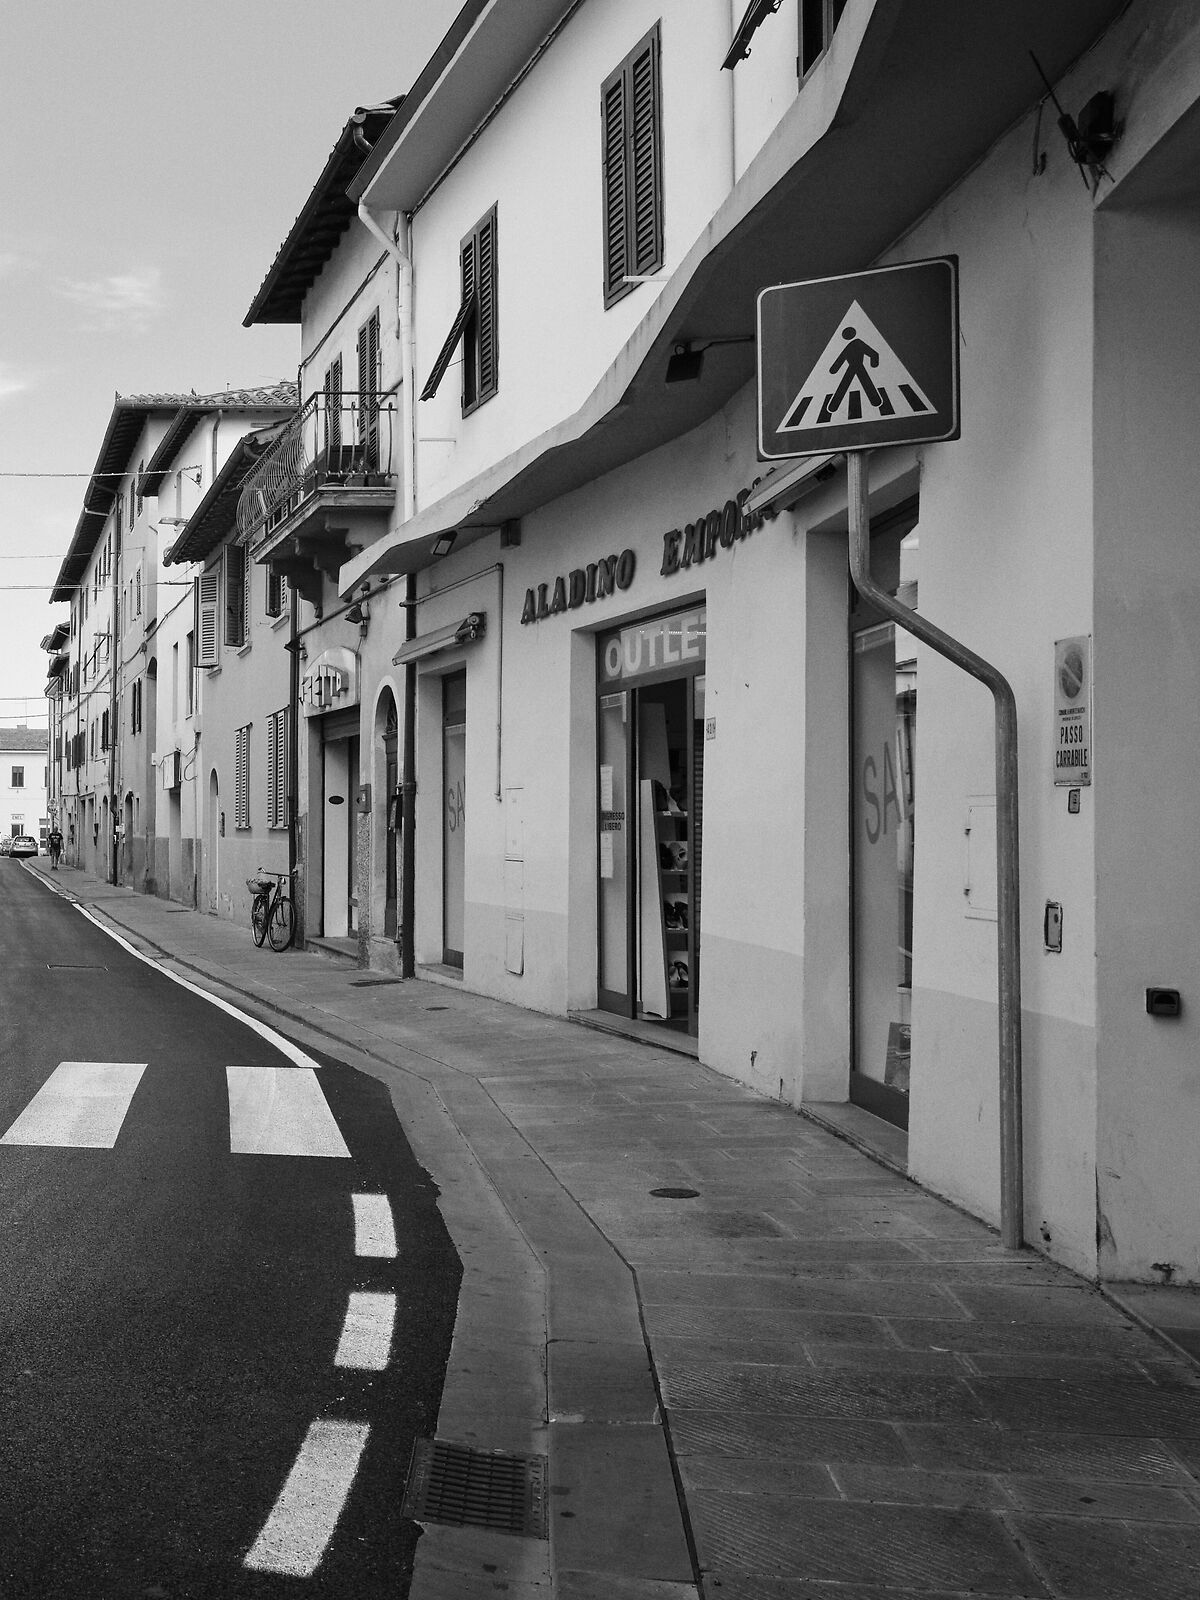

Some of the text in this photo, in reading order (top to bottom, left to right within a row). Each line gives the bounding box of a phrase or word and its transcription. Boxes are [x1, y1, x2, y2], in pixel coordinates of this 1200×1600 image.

[520, 549, 636, 624] ALADINO
[604, 613, 706, 677] OUTLE
[1060, 724, 1083, 745] PASSO
[1056, 748, 1088, 768] CARRABILE
